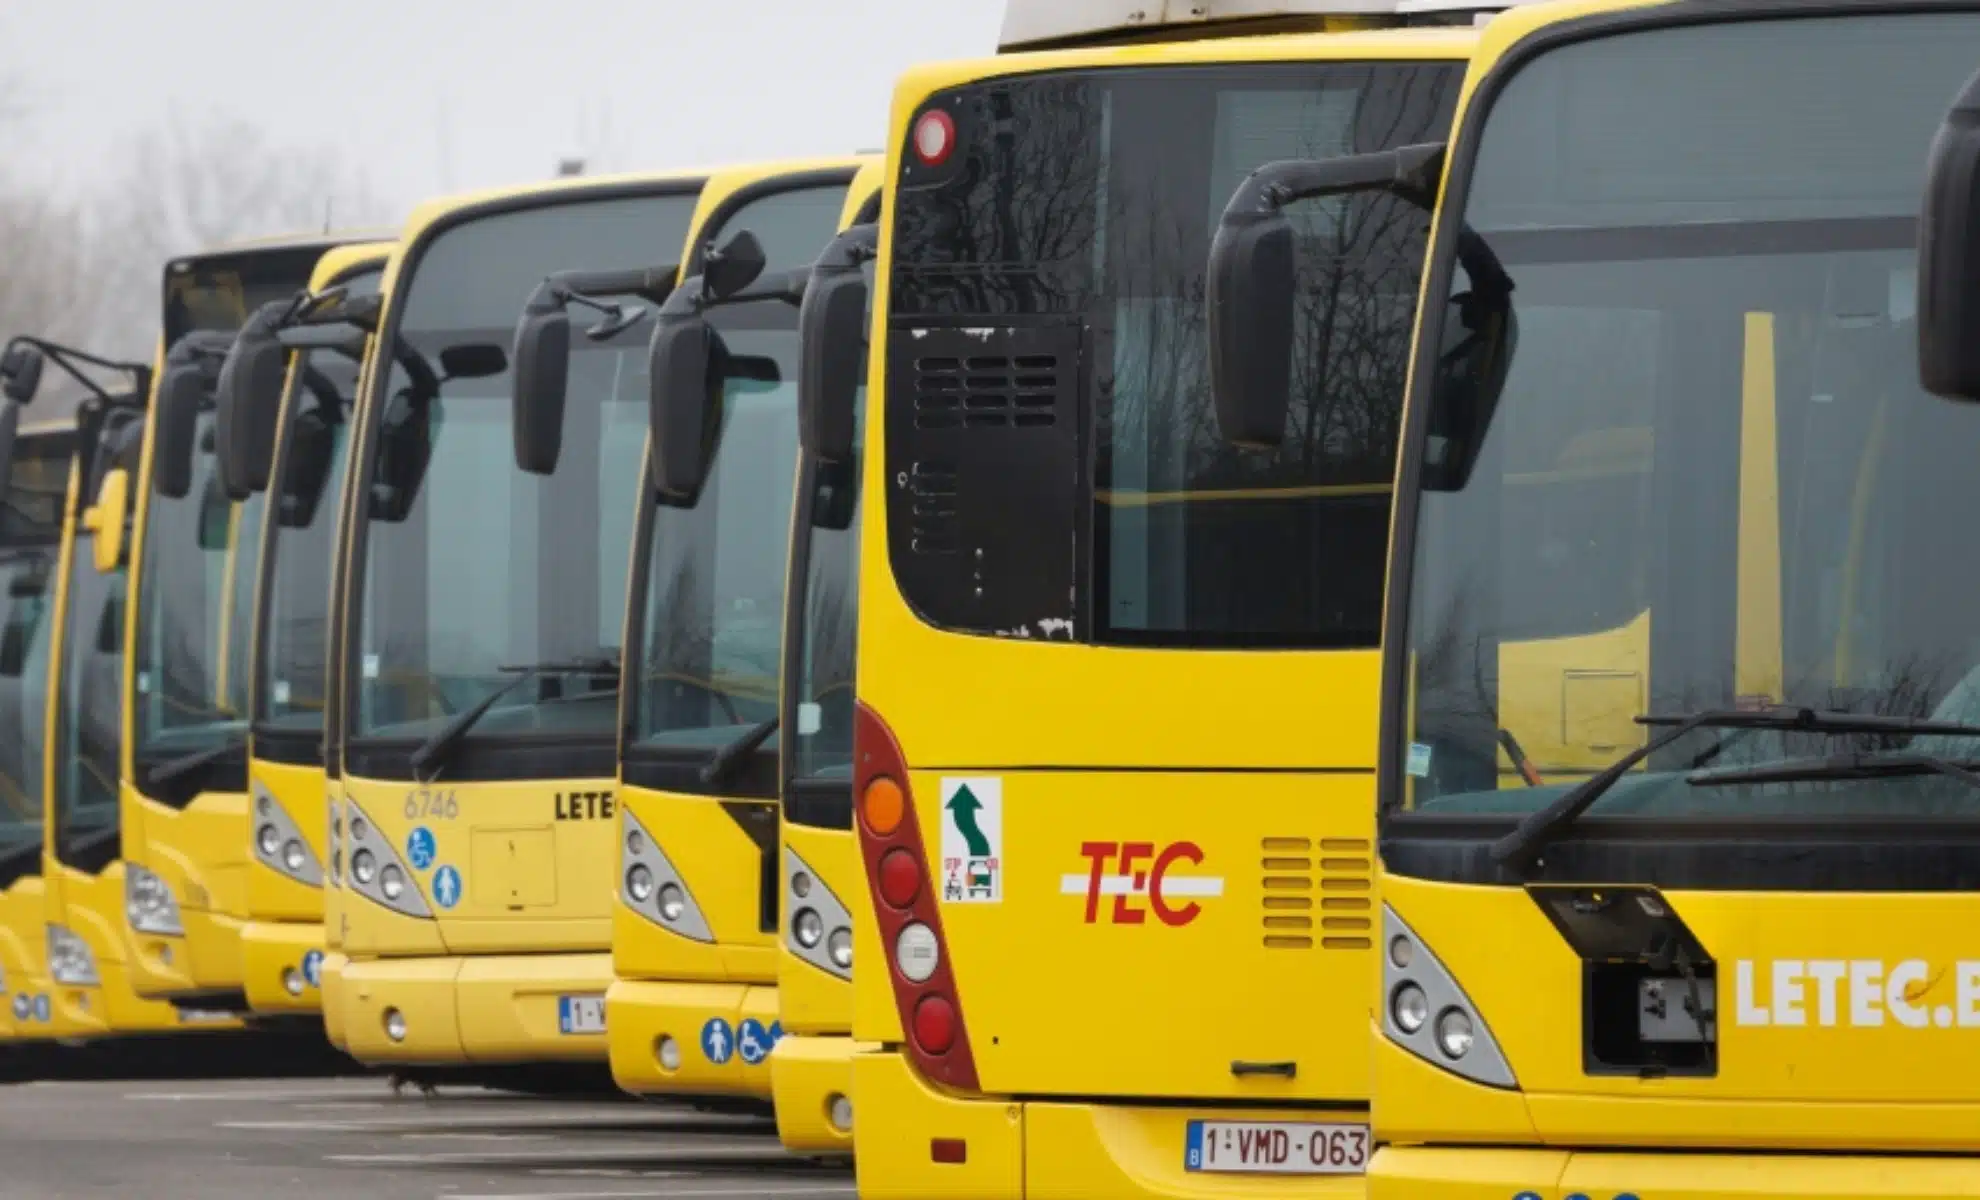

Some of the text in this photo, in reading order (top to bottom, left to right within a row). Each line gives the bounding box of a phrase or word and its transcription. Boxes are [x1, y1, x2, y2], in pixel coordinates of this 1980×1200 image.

[404, 789, 459, 820] 6746
[554, 791, 617, 820] LETE
[1080, 841, 1204, 927] TEC
